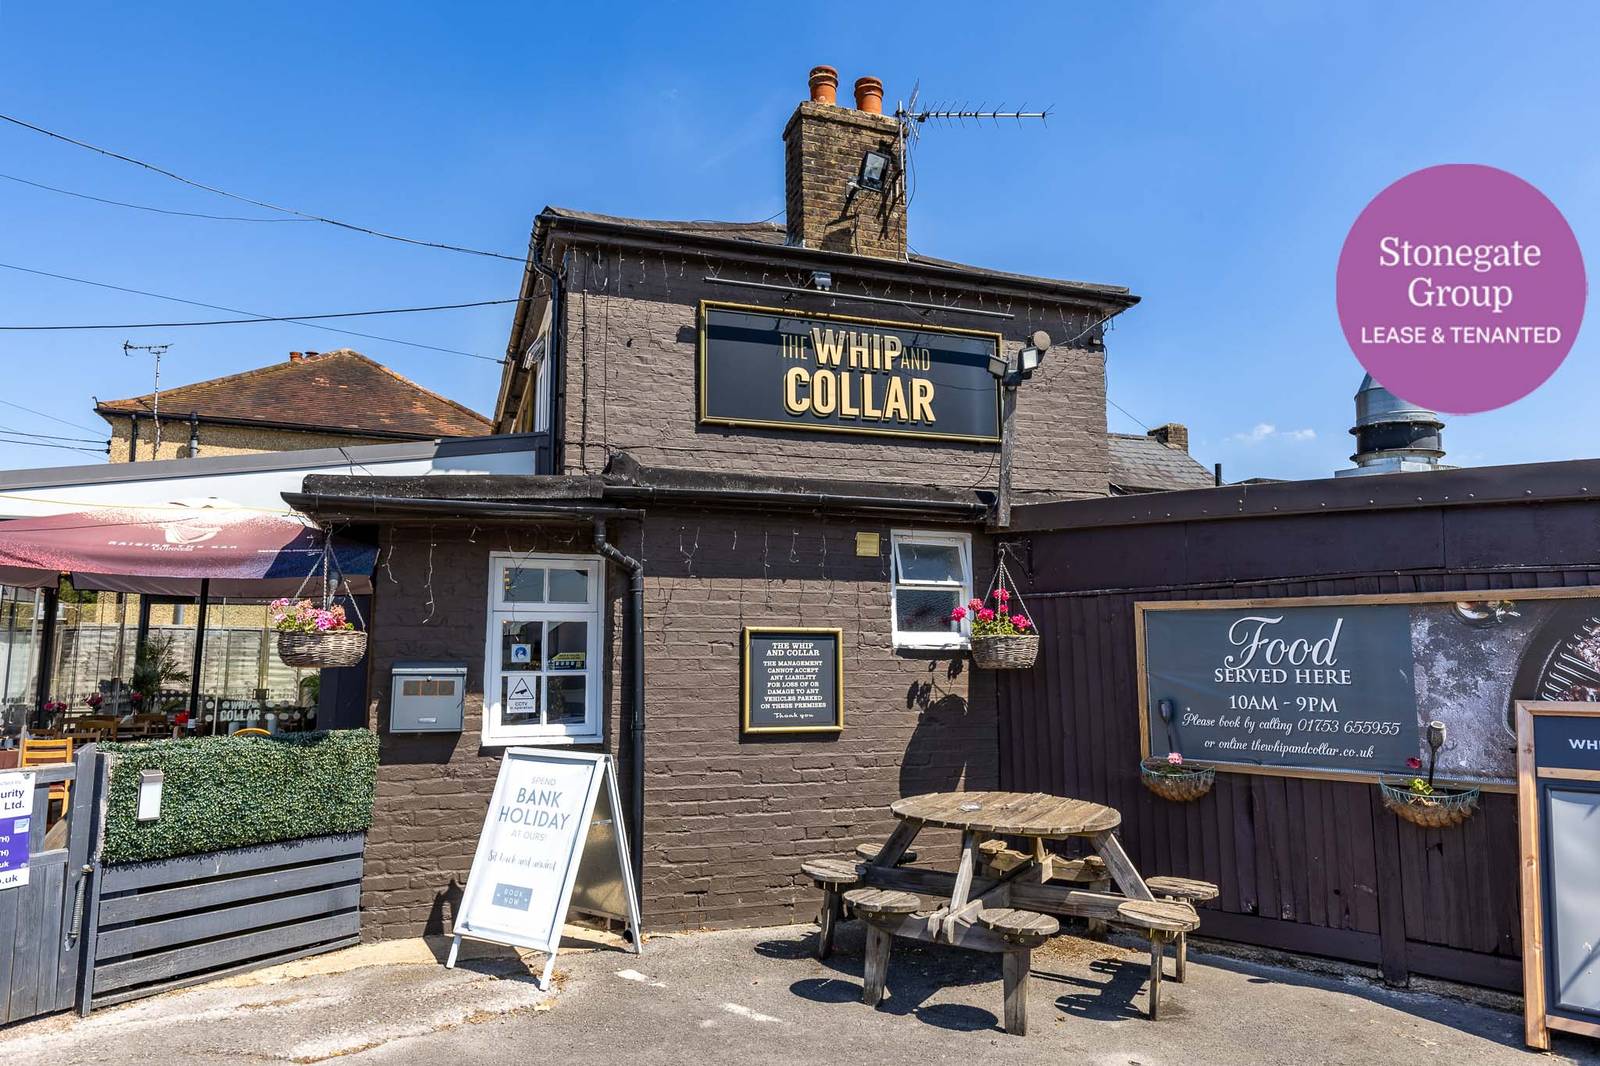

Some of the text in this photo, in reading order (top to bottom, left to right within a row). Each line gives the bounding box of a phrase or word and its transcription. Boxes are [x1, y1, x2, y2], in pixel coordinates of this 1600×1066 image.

[780, 328, 931, 373] THE WHIP AND
[784, 367, 936, 424] COLLAR
[1224, 615, 1344, 670] Food
[1214, 668, 1352, 686] SERVED HERE
[1228, 694, 1280, 712] 10AM
[1296, 696, 1339, 713] 9PM
[1182, 712, 1401, 736] Please book by calling 01753 655955
[1204, 738, 1375, 758] or online thewhipandcollar.co.uk
[1568, 738, 1600, 750] WH
[531, 776, 556, 786] SPEND
[4, 800, 24, 810] Ltd.
[516, 787, 563, 808] BANK
[498, 805, 571, 830] HOLIDAY
[0, 874, 18, 884] .uk
